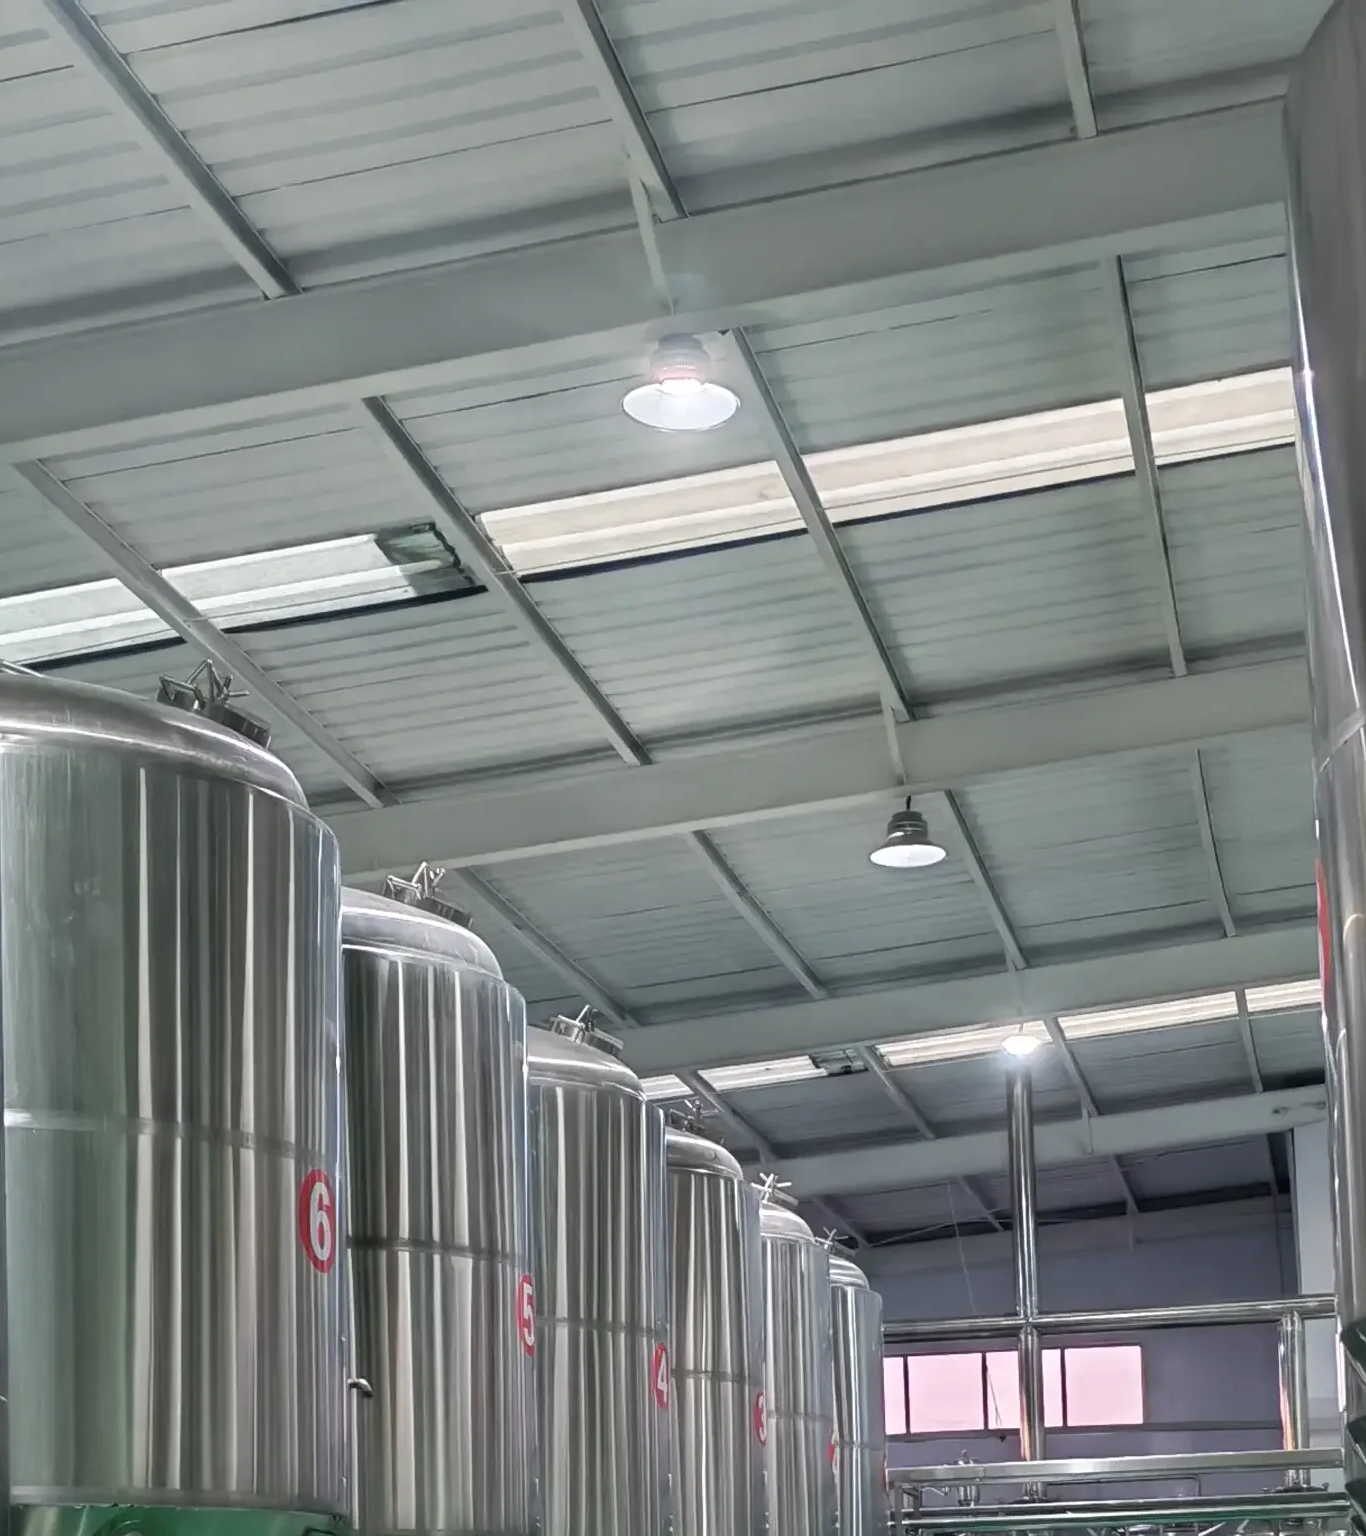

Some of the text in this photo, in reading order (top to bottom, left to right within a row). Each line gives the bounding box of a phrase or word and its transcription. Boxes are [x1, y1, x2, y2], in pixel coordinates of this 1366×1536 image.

[309, 1181, 332, 1261] 6
[523, 1282, 535, 1347] 5
[657, 1349, 668, 1405] 4
